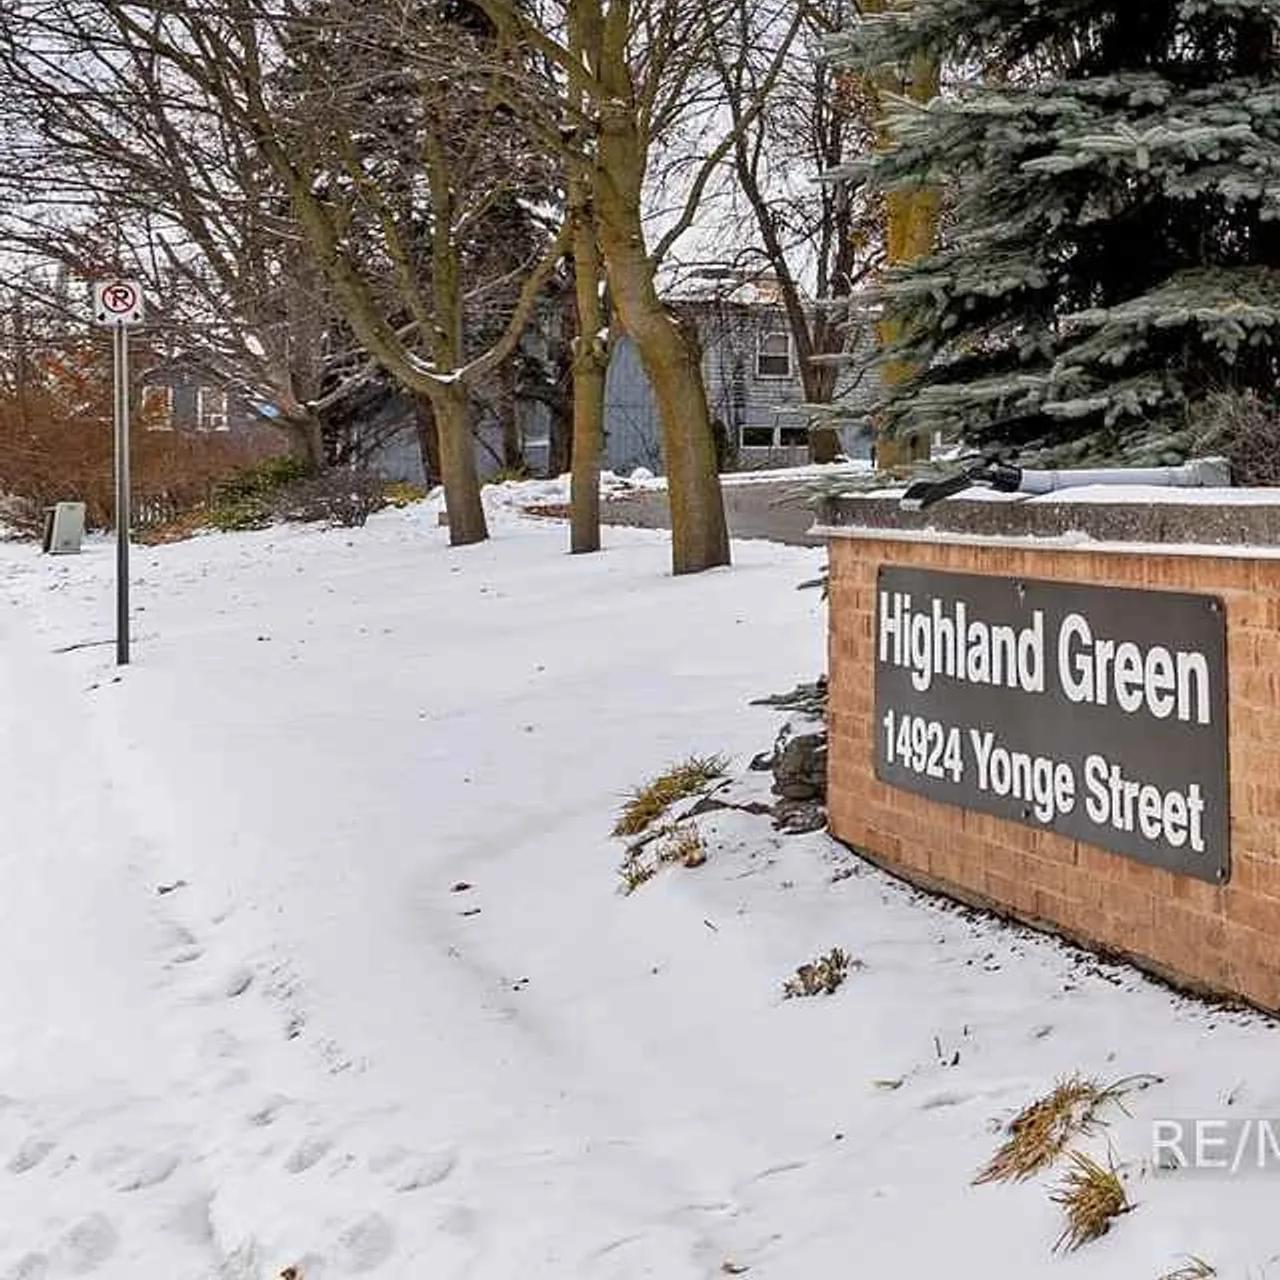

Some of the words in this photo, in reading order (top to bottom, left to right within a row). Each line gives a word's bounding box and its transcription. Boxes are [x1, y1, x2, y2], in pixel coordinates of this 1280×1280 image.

[879, 591, 1045, 692] Highland
[1058, 613, 1211, 723] Green
[884, 709, 963, 783] 14924
[970, 729, 1075, 823] Yonge
[1085, 755, 1204, 852] Street
